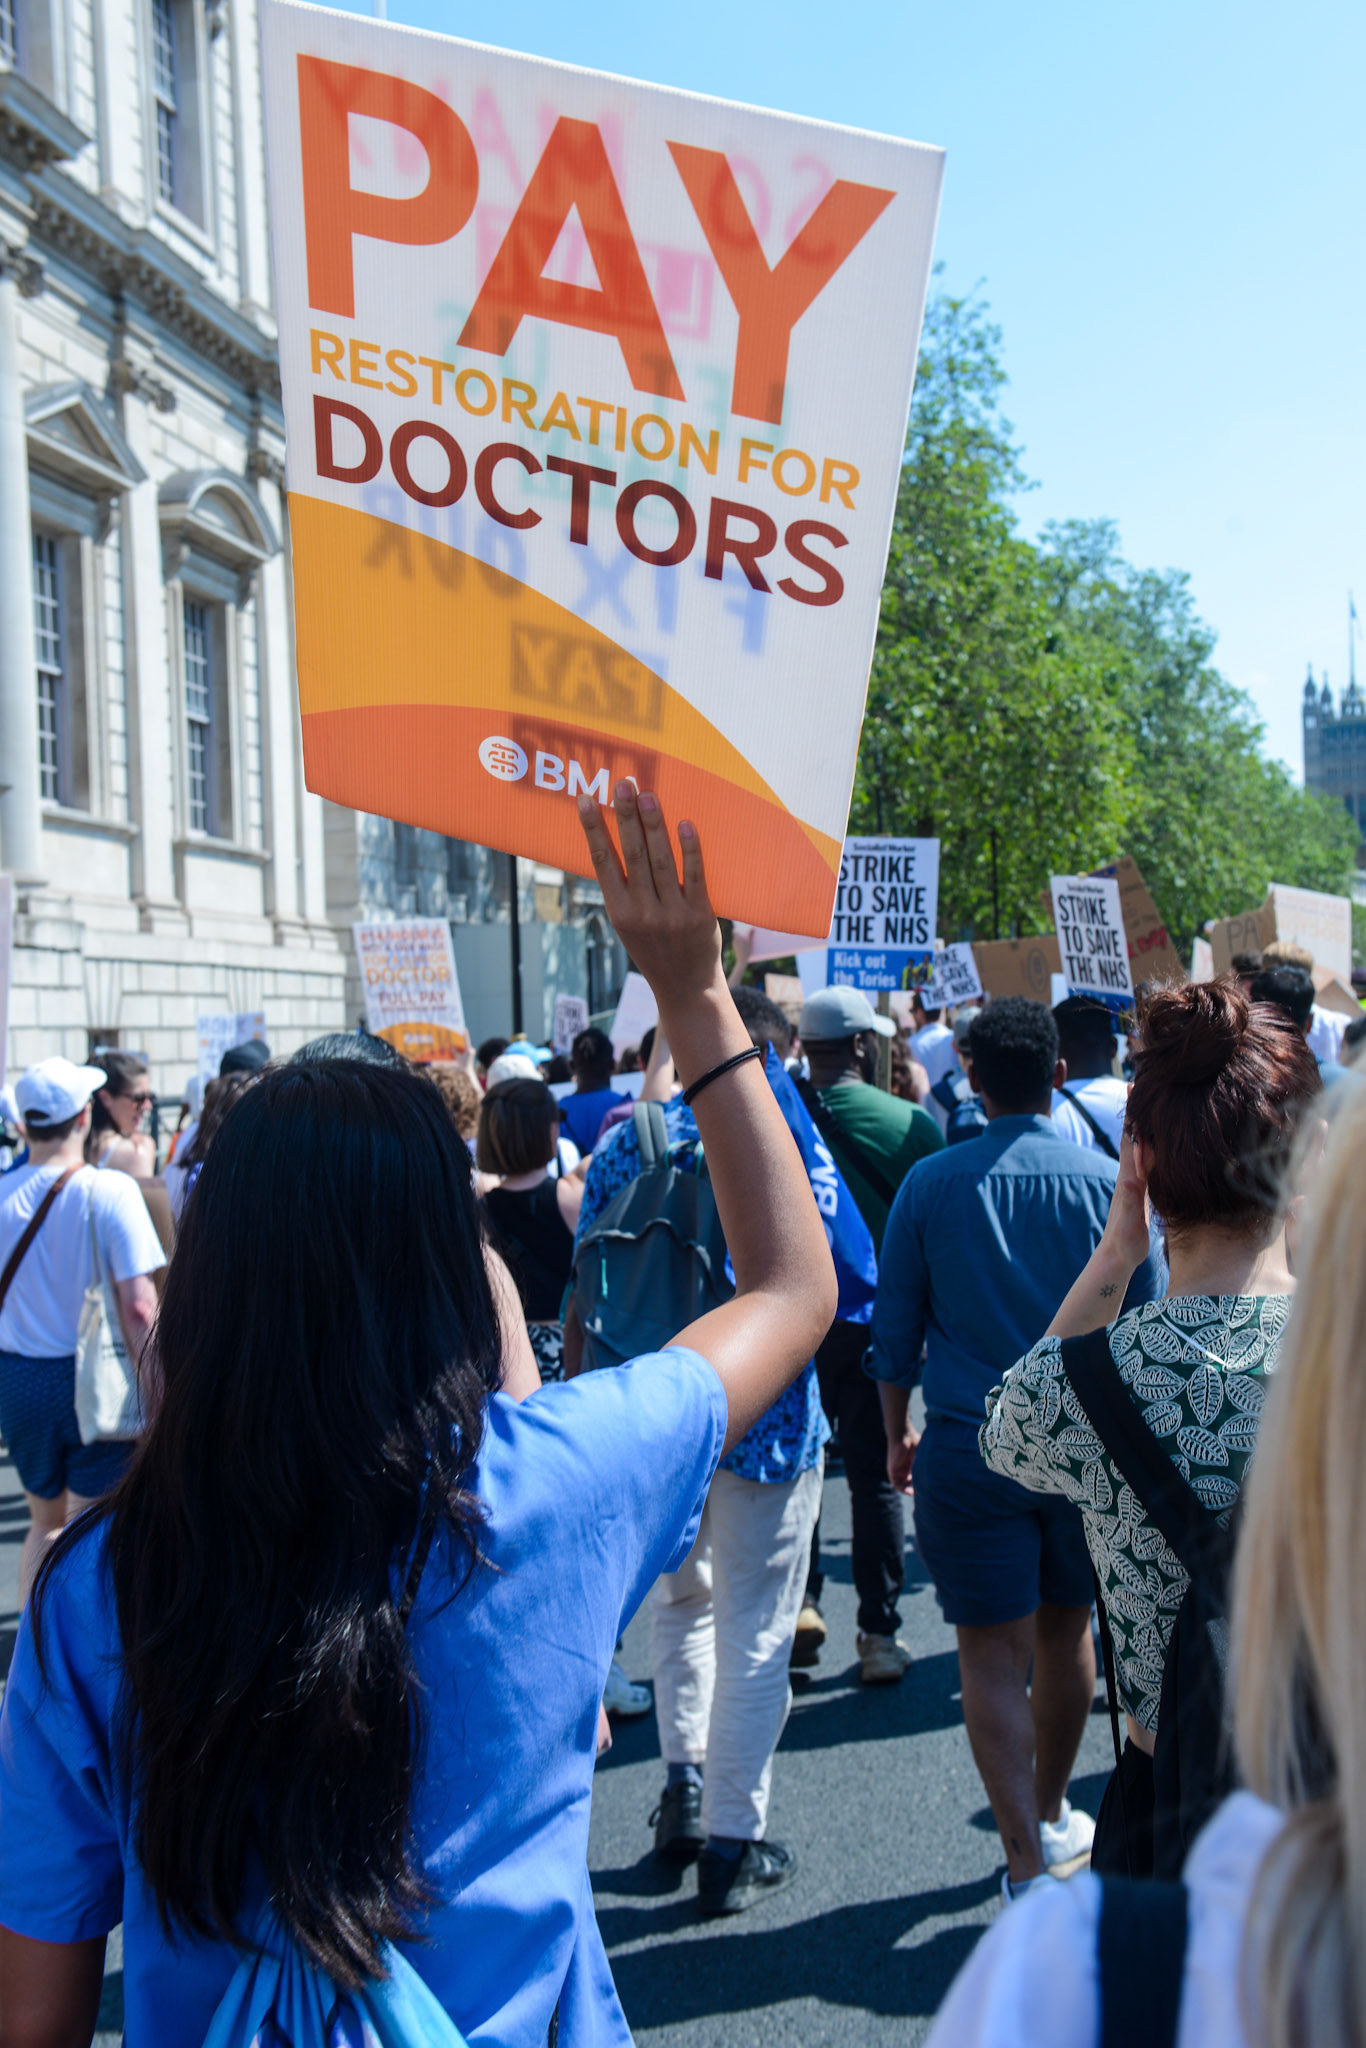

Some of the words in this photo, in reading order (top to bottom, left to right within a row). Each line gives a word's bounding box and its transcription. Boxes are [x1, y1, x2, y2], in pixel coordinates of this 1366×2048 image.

[296, 52, 898, 426] PAY
[309, 328, 720, 475] RESTORATION
[737, 437, 861, 510] FOR
[312, 394, 850, 607] DOCTORS
[534, 750, 640, 808] BM
[840, 854, 915, 883] STRIKE
[838, 885, 862, 912] TO
[872, 886, 926, 914] SAVE
[1058, 895, 1109, 926] STRIKE
[834, 915, 875, 942] THE
[885, 917, 928, 944] NHS
[1061, 925, 1083, 953] TO
[1086, 927, 1121, 958] SAVE
[366, 966, 451, 985] DOCTOR
[833, 952, 861, 968] Kick
[865, 953, 886, 969] out
[1065, 956, 1095, 984] THE
[1098, 960, 1128, 988] NHS
[833, 971, 855, 986] the
[858, 971, 896, 987] Tories
